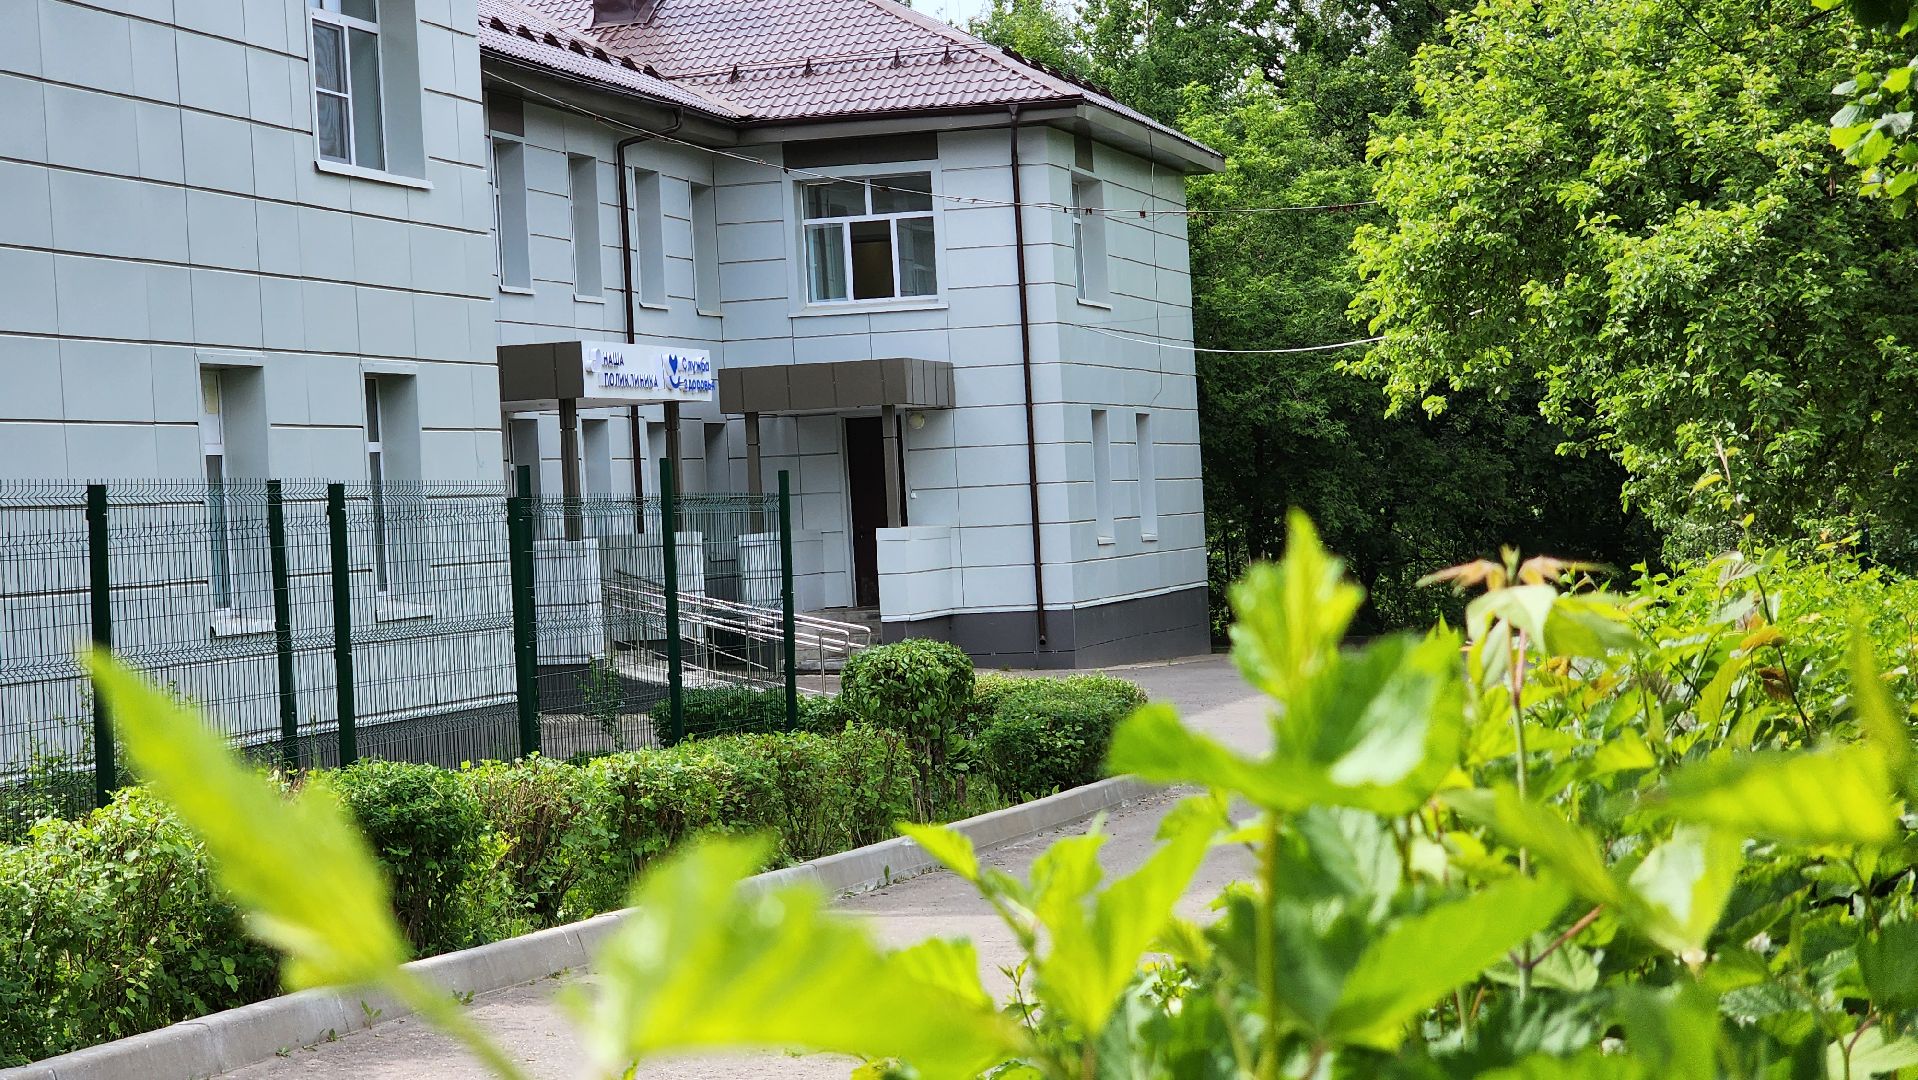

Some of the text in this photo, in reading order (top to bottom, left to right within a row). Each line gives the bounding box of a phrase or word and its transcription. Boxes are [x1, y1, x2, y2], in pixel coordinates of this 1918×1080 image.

[603, 352, 624, 366] НАША
[681, 357, 710, 374] Служба
[604, 373, 658, 388] ПОЛИКЛИНИКА
